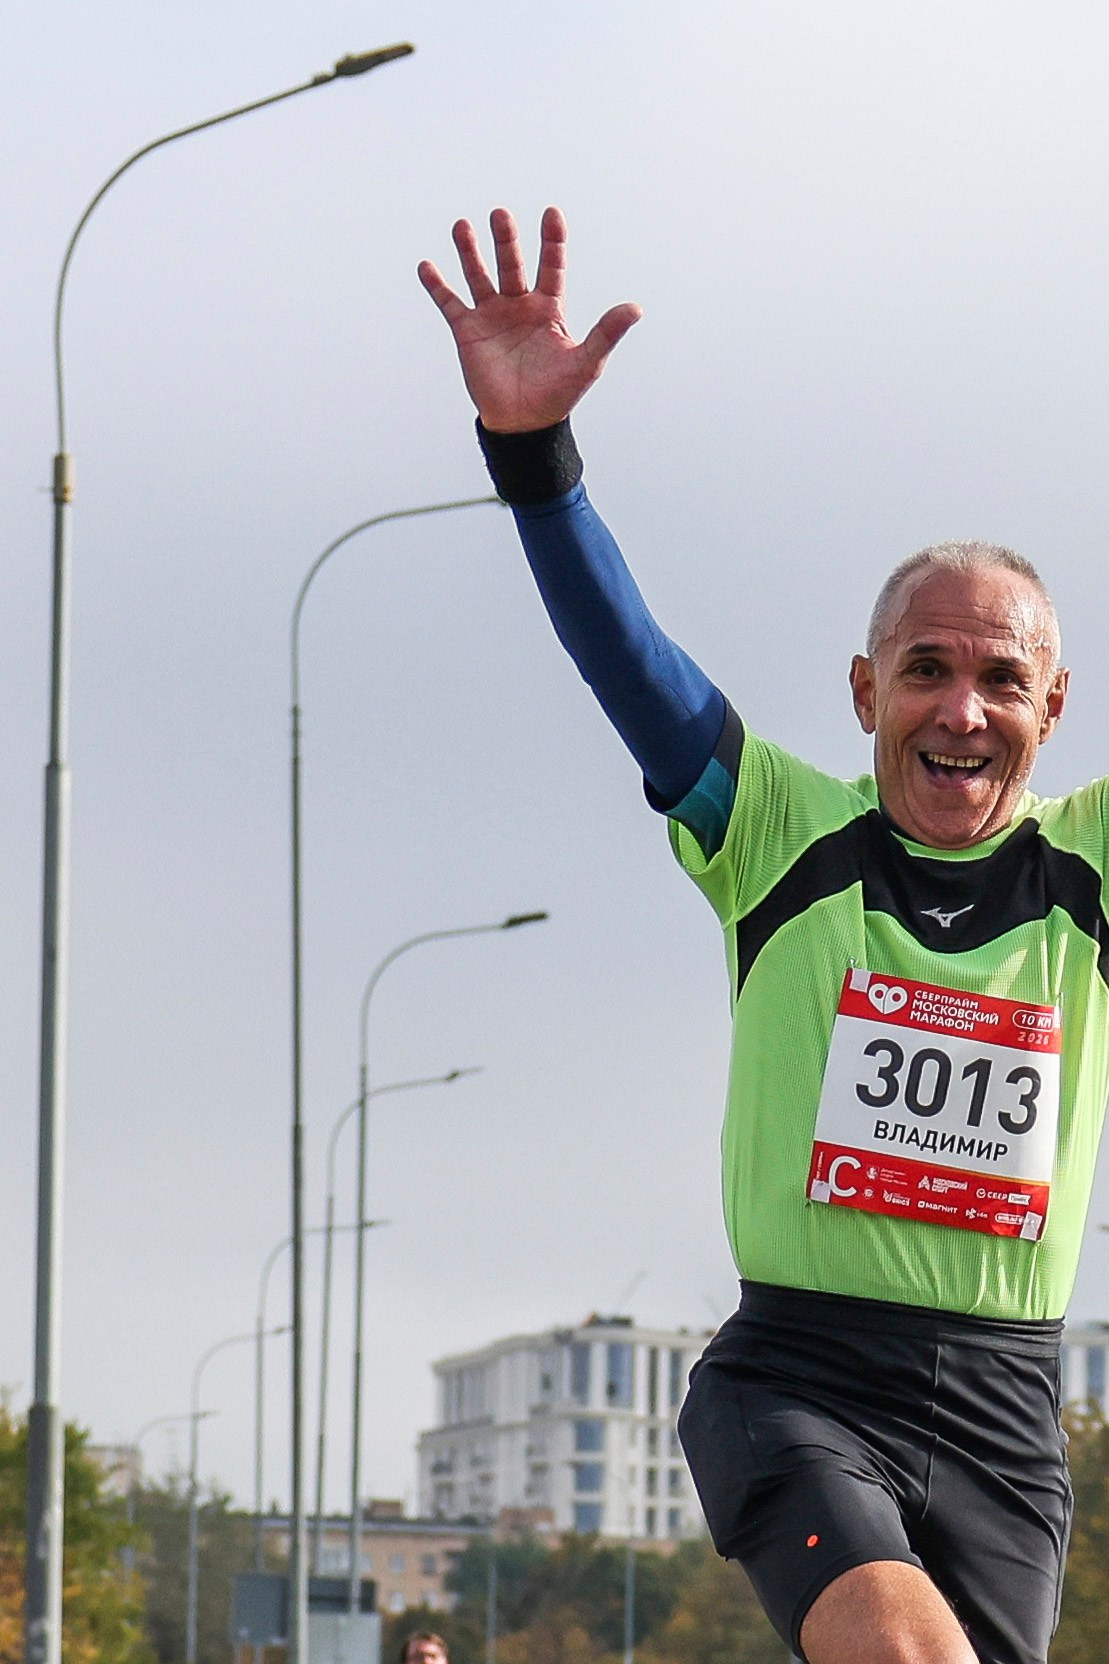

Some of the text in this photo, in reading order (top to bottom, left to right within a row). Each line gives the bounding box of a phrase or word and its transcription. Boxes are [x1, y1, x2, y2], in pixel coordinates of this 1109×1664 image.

[911, 999, 1000, 1026] МОСКОВСКИЙ
[914, 990, 979, 1010] СБЕРПРАЙМ
[909, 1010, 976, 1033] МАРАФОН
[1021, 1013, 1036, 1026] 10
[855, 1037, 1042, 1136] 3013
[872, 1119, 1010, 1163] ВЛАДИМИР
